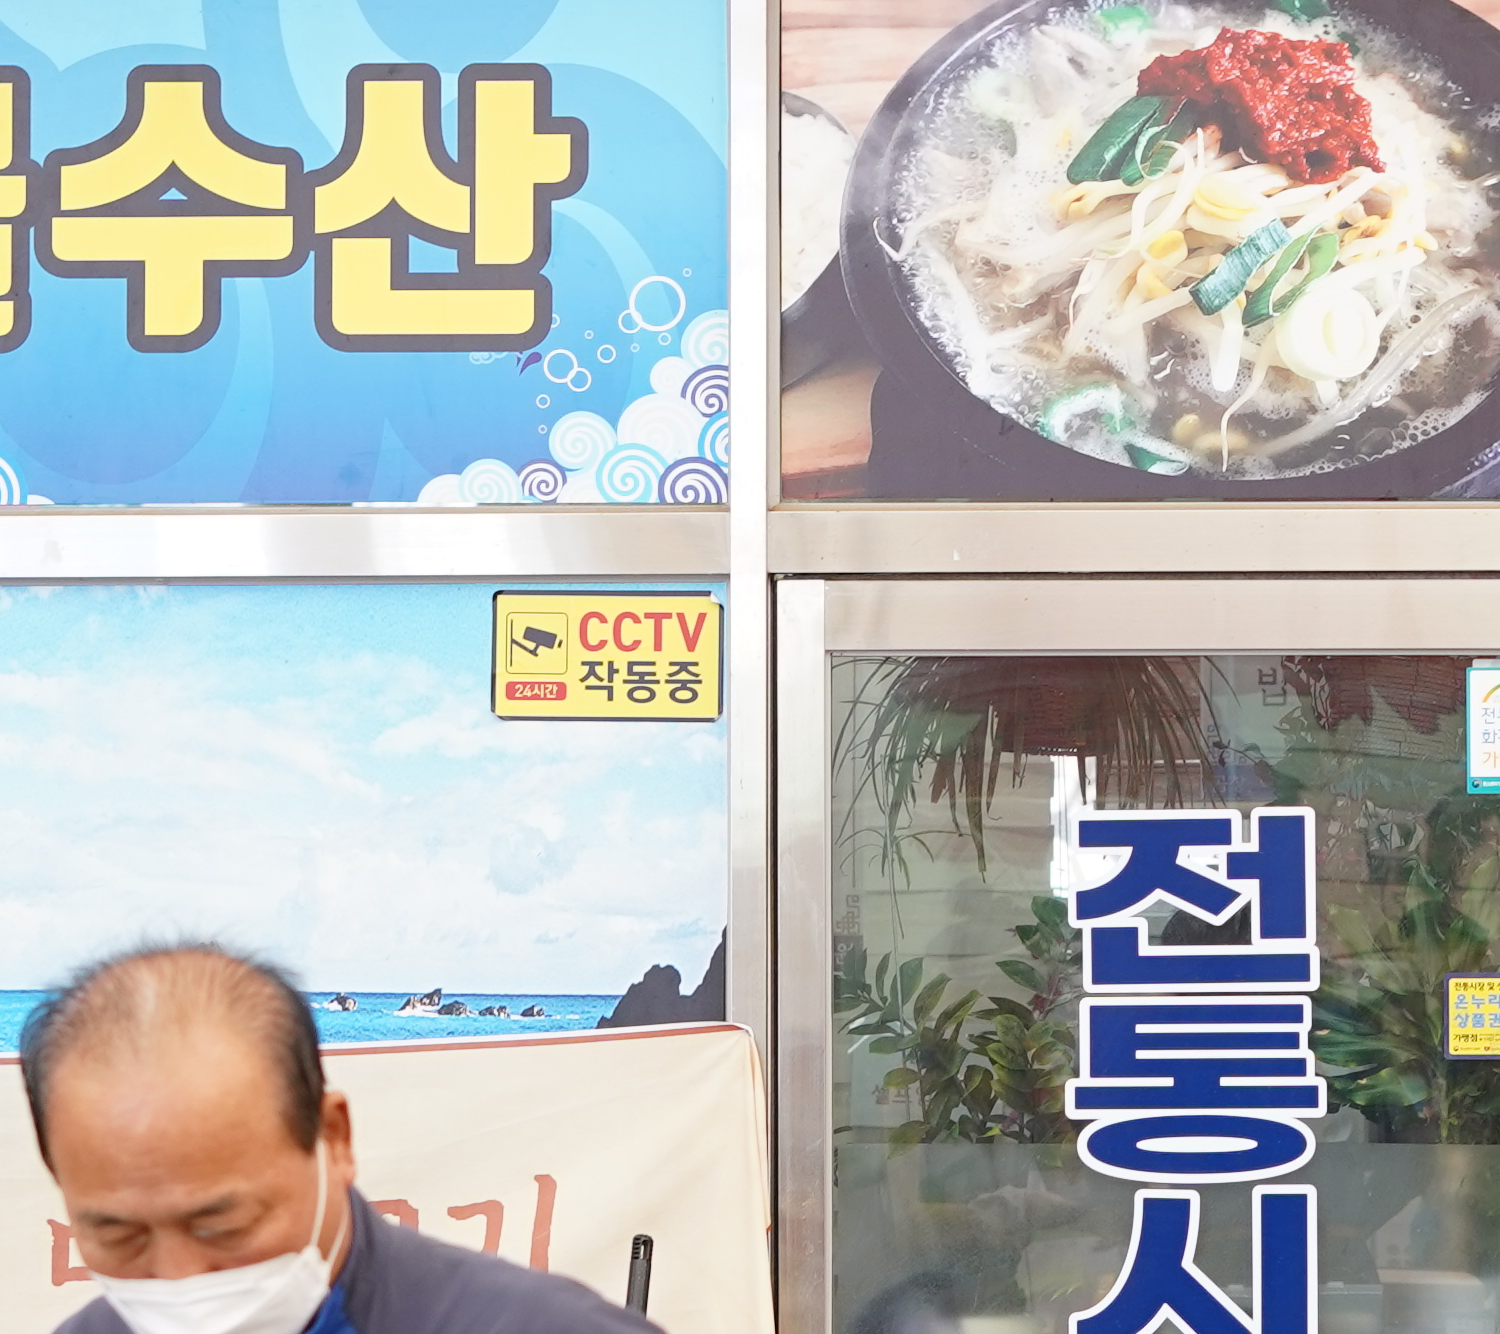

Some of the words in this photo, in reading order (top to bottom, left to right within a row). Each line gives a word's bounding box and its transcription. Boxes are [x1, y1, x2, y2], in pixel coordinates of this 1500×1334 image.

[579, 612, 707, 653] CCTV
[514, 683, 559, 698] 24시간
[579, 661, 703, 704] 작동중
